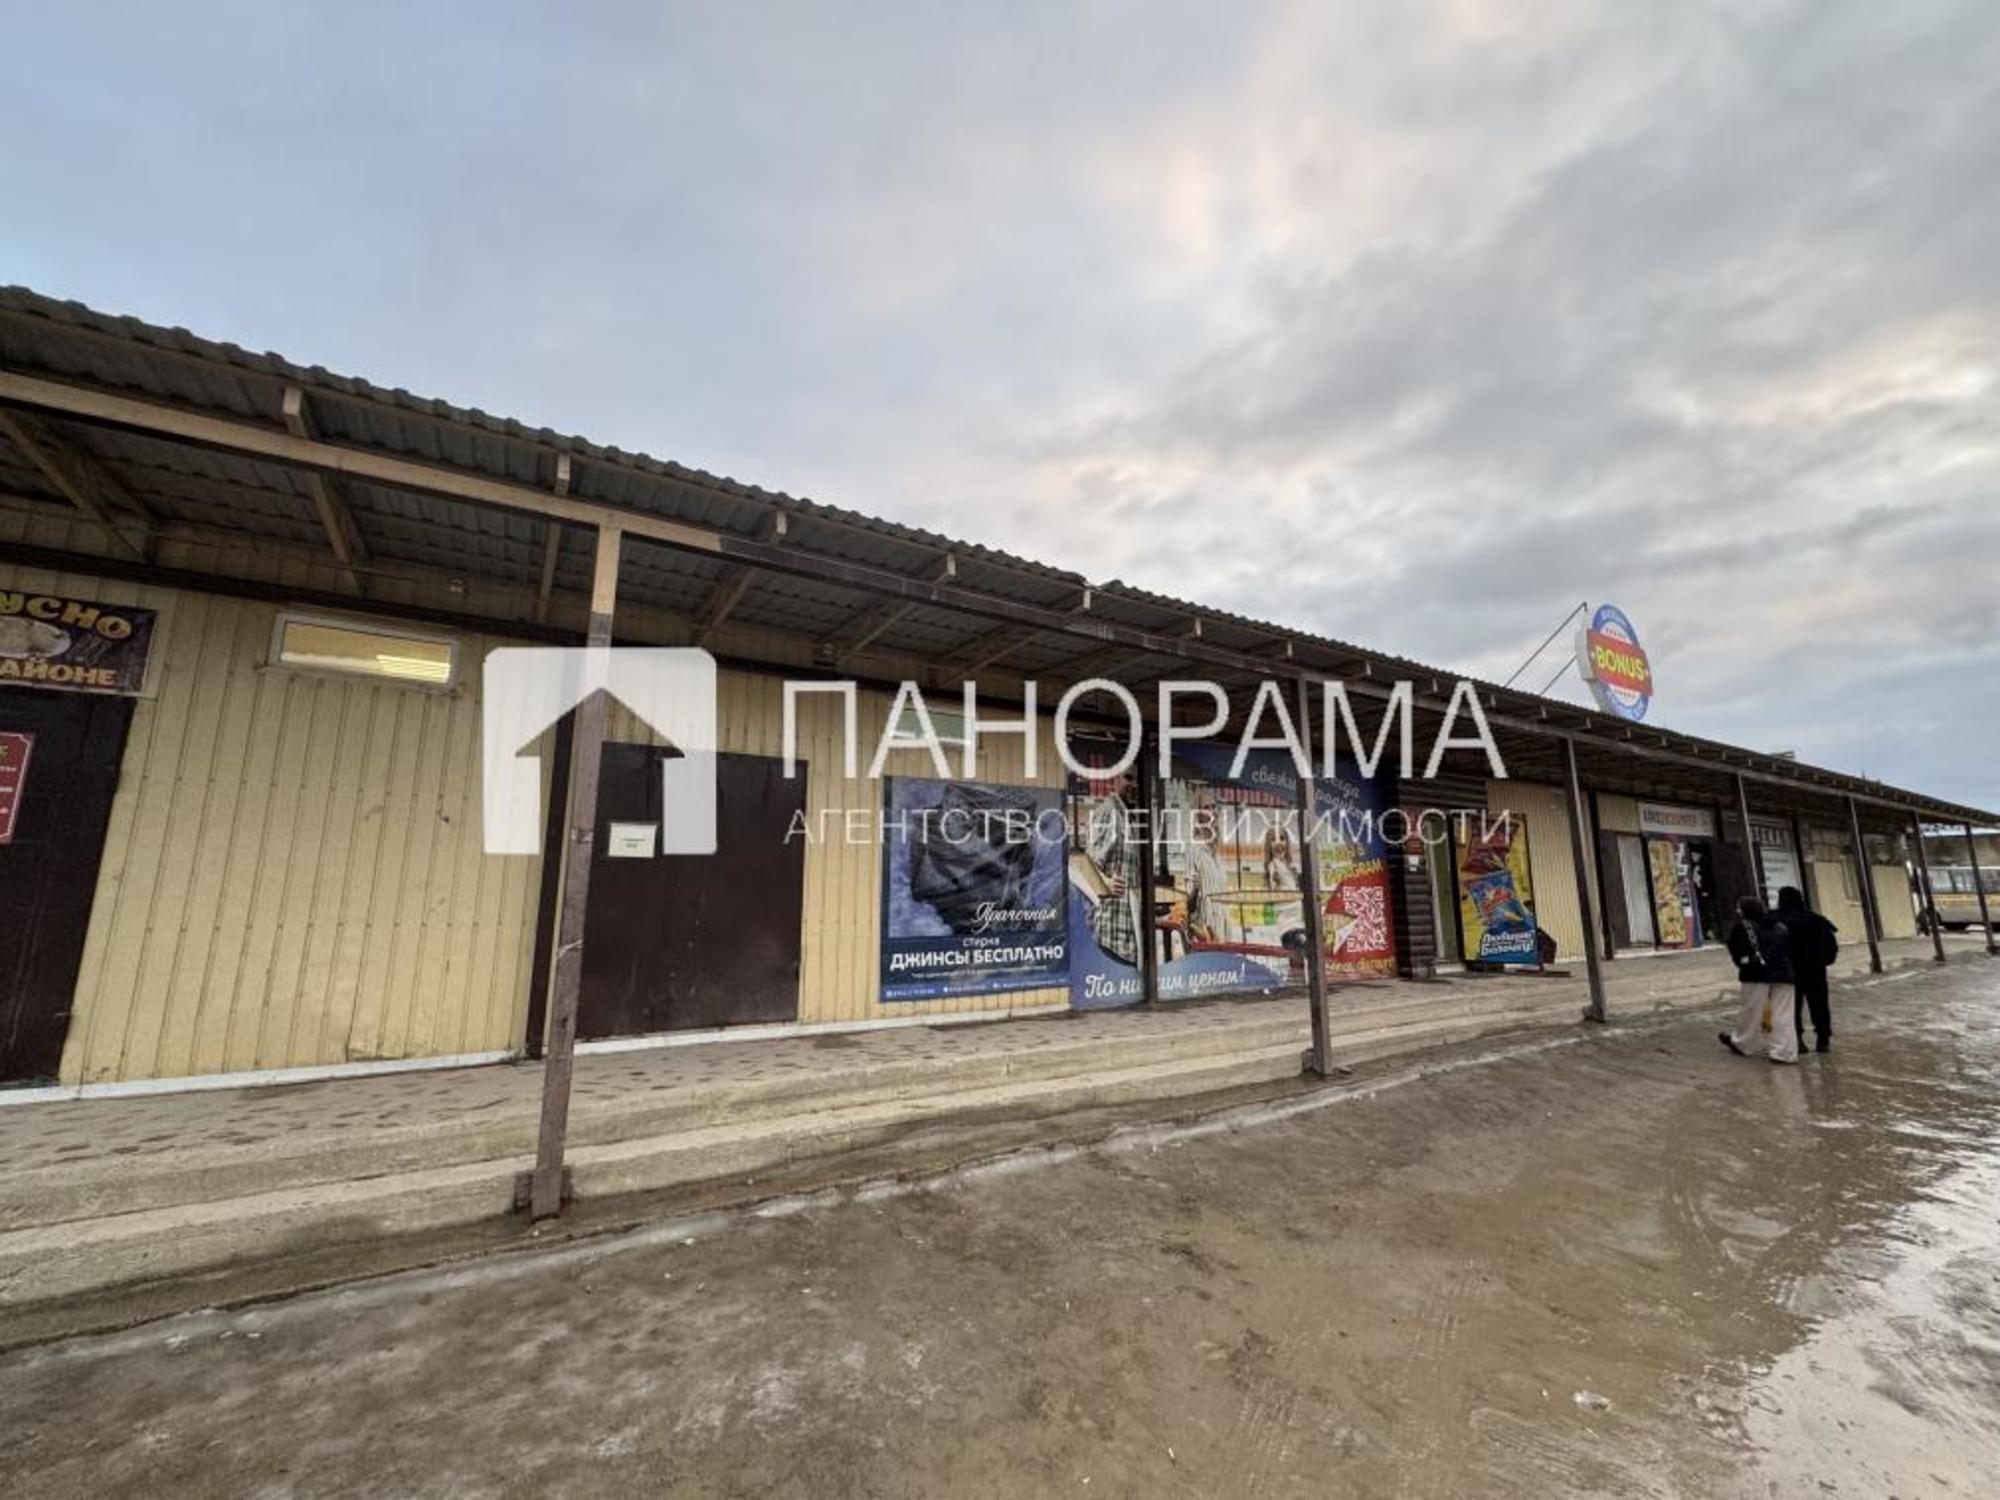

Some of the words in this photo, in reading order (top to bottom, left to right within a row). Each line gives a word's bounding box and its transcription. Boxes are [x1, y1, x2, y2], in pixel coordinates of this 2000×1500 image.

[1595, 645, 1645, 681] BONUS
[969, 902, 1058, 934] Прачечная
[889, 951, 970, 971] ДЖИНСЫ
[973, 945, 1064, 965] БЕСПЛАТНО
[1084, 974, 1115, 998] По
[1119, 976, 1184, 995] ниим
[1188, 962, 1245, 991] ценам!
